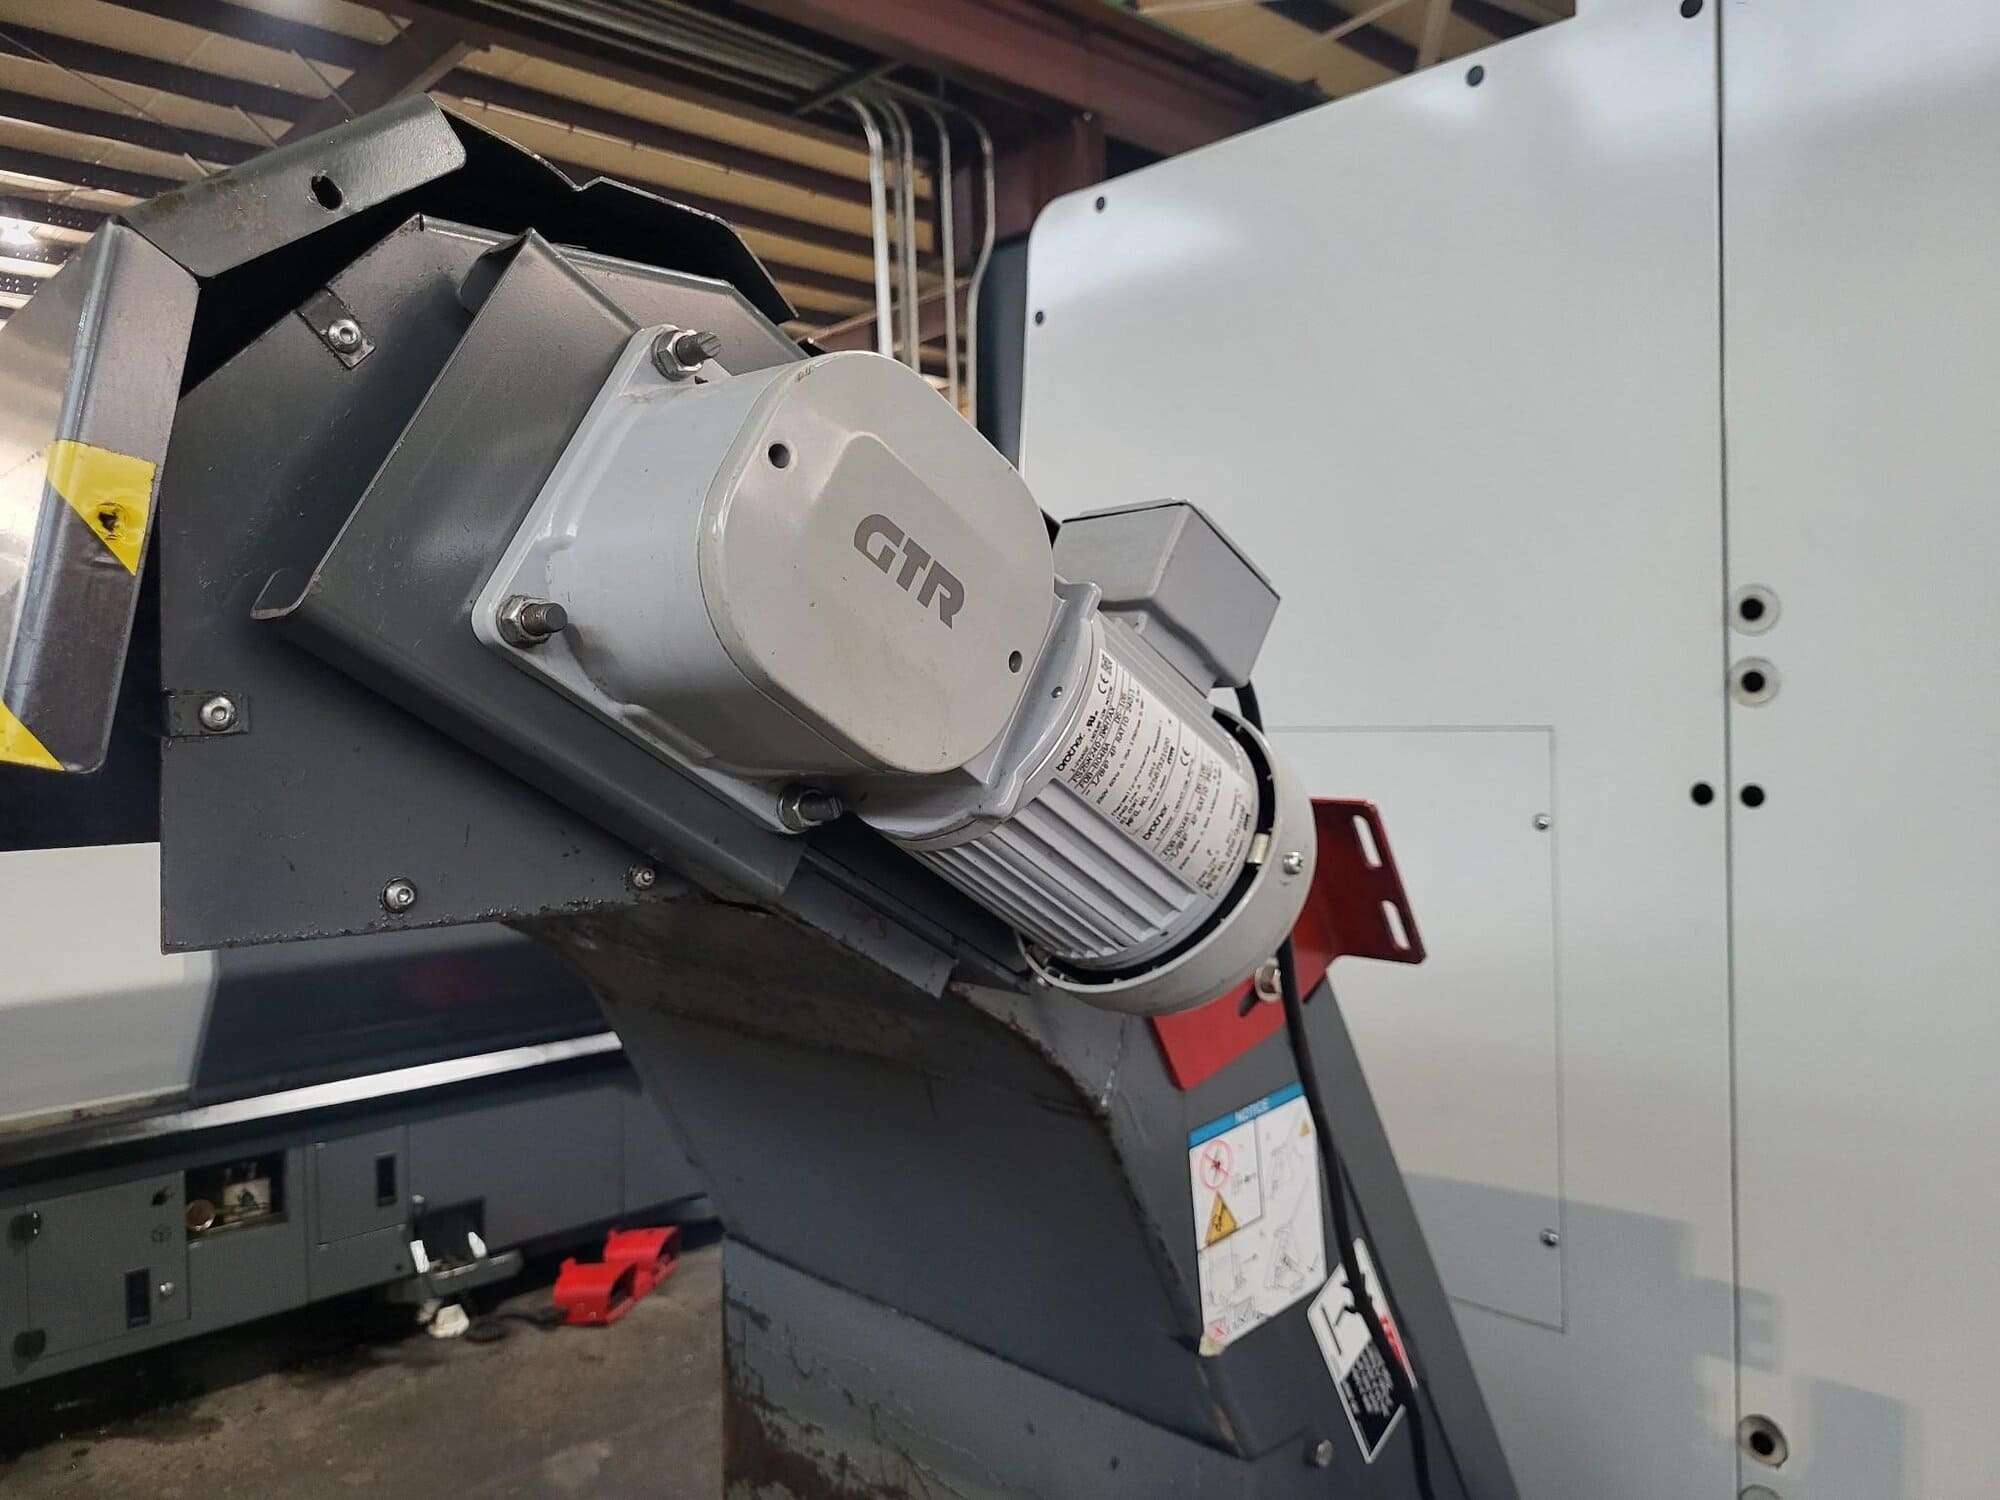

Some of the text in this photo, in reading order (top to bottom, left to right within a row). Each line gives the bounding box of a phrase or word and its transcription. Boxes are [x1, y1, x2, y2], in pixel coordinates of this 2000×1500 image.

[854, 513, 965, 629] GTR
[1055, 730, 1085, 772] brother
[1142, 801, 1169, 841] brother
[1234, 1098, 1270, 1124] NOTICE
